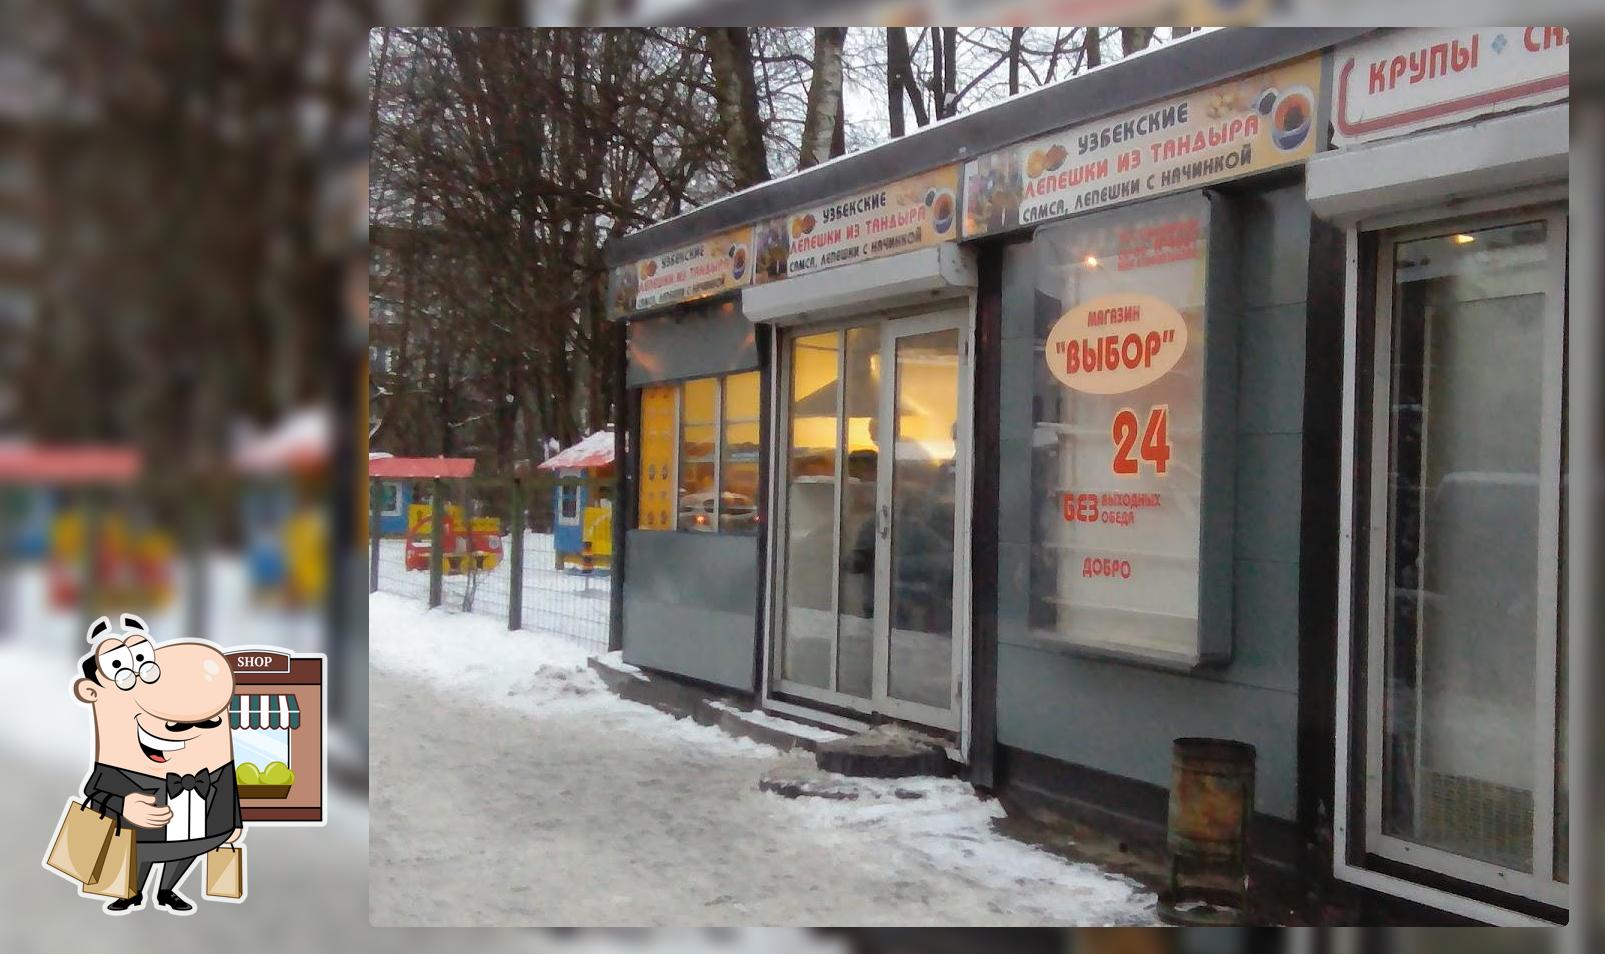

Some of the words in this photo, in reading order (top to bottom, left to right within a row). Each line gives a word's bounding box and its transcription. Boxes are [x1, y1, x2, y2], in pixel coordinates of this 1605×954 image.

[1369, 34, 1479, 95] КРУПЫ
[1523, 27, 1569, 53] СА
[1077, 102, 1189, 155] УЗБЕКСКИЕ
[1024, 161, 1109, 199] ЛЕПЕШКИ
[1116, 152, 1141, 173] ИЗ
[1150, 114, 1259, 163] ТАНДЫРА
[1022, 197, 1069, 224] САМСА,
[1074, 178, 1140, 211] ЛЕПЕШКИ
[1146, 174, 1154, 190] С
[1161, 143, 1252, 187] НАЧИНКОЙ
[790, 231, 841, 255] ЛЕПЕШКИ
[846, 225, 860, 240] ИЗ
[866, 205, 926, 234] ТАНДЫРА
[822, 191, 887, 224] УЗБЕКСКИЕ
[789, 256, 818, 273] САМСА,
[820, 245, 860, 266] ЛЕПЕШКИ
[862, 243, 868, 255] С
[871, 226, 922, 254] НАЧИНКОЙ
[1087, 305, 1141, 328] МАГАЗИН
[1055, 329, 1175, 374] "ВЫБОР"
[1112, 406, 1170, 475] 24
[1063, 493, 1099, 522] БЕЗ
[1101, 493, 1161, 510] ВЫХОДНЫХ
[1101, 510, 1135, 527] ОБЕДА
[1082, 557, 1132, 579] ДОБРО
